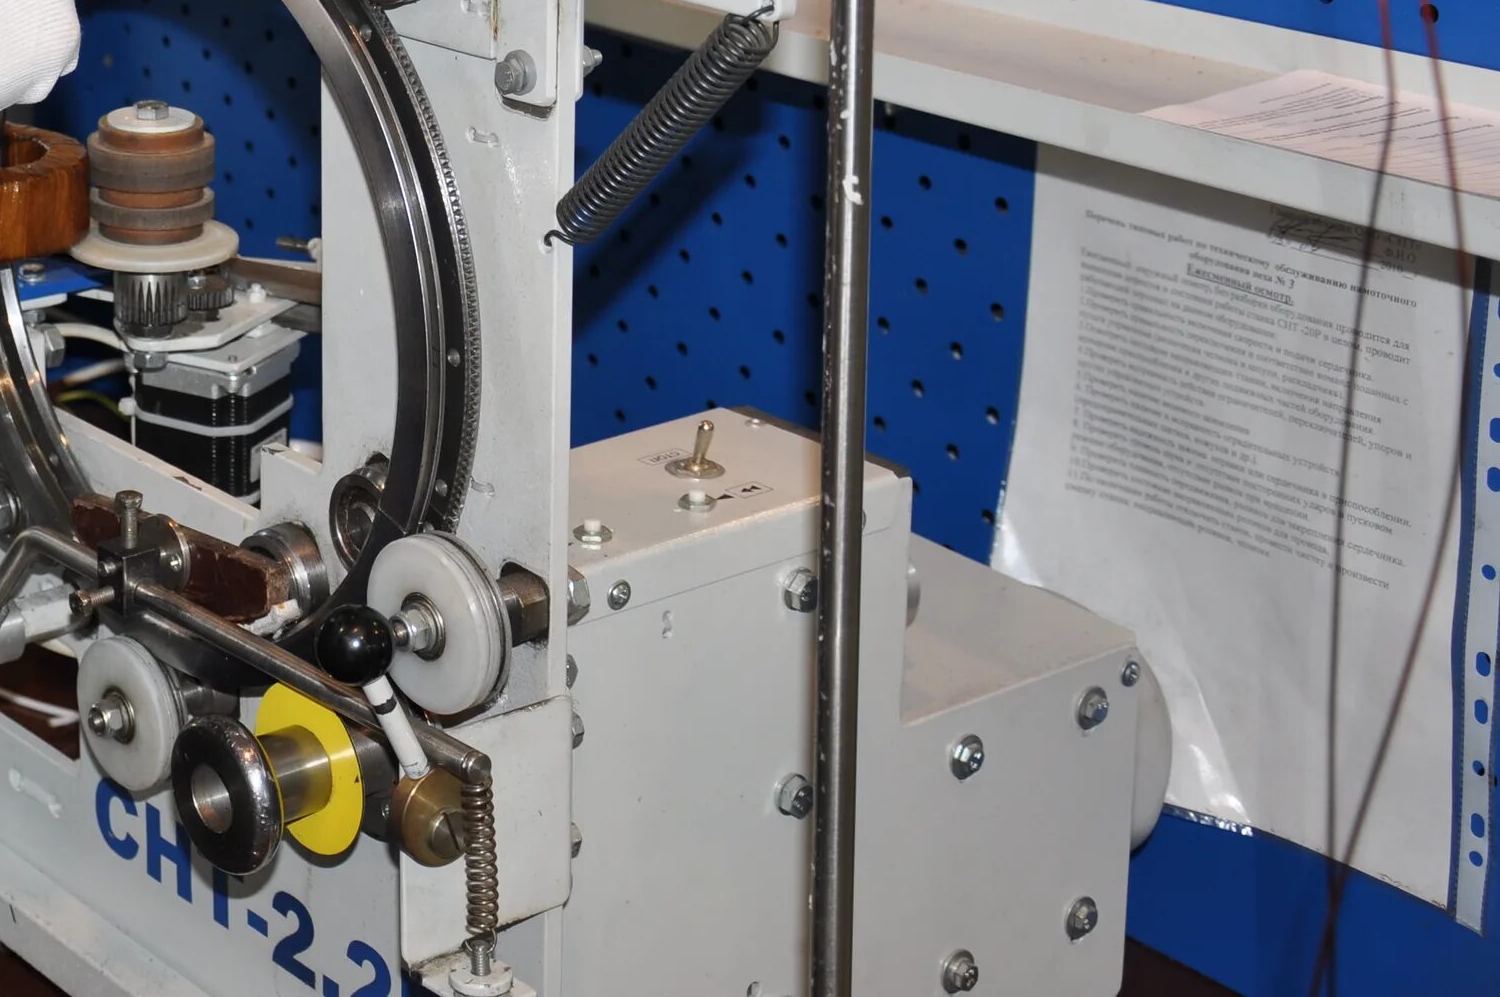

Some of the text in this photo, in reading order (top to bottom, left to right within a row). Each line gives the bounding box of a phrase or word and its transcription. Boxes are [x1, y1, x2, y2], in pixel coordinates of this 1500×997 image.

[1274, 261, 1347, 292] обслуживанию
[1254, 286, 1293, 305] осмотр.
[1365, 344, 1410, 368] проводит
